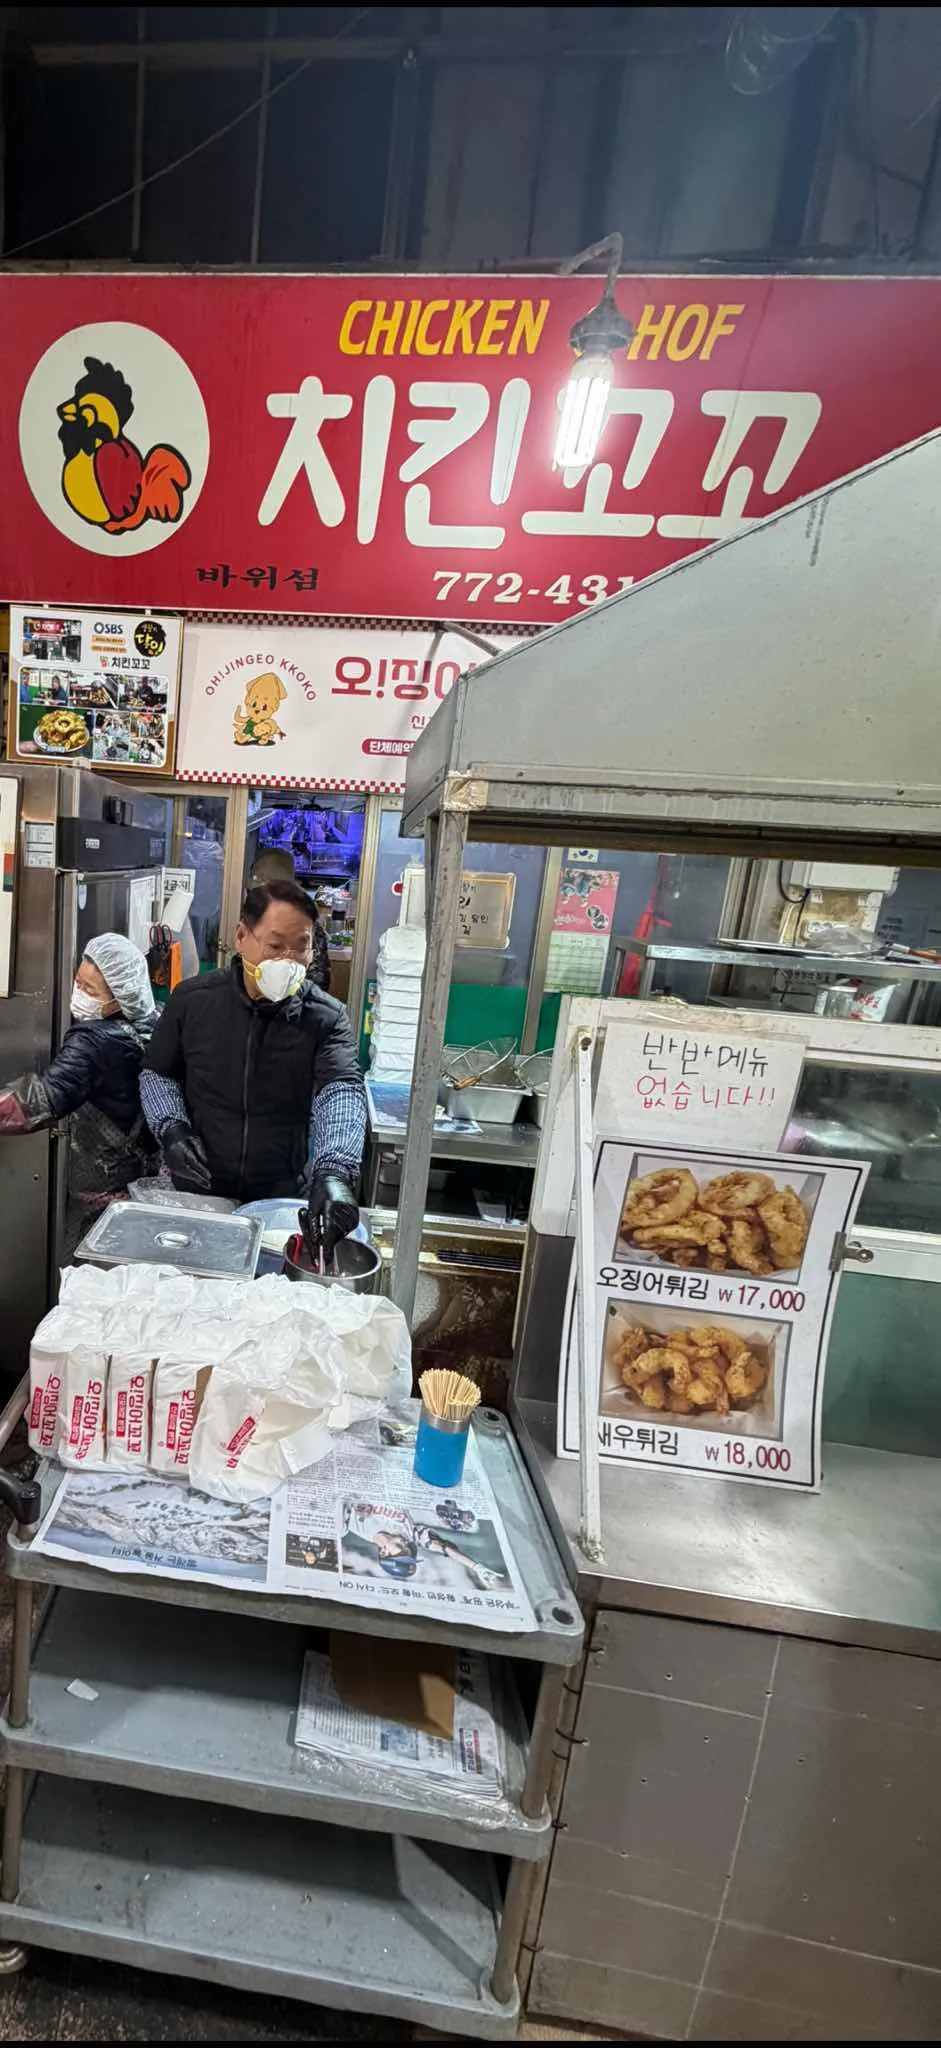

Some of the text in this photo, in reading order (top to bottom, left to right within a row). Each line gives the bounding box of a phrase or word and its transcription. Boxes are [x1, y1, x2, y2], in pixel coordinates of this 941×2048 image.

[339, 299, 745, 361] CHICKEN HOF
[258, 375, 822, 548] 치킨꼬꼬
[196, 563, 318, 591] 바위섬
[111, 657, 151, 670] 치킨꼬꼬
[280, 658, 317, 701] KKOKO
[636, 1074, 777, 1110] 없습니다!!
[596, 1266, 708, 1301] 오징어튀김
